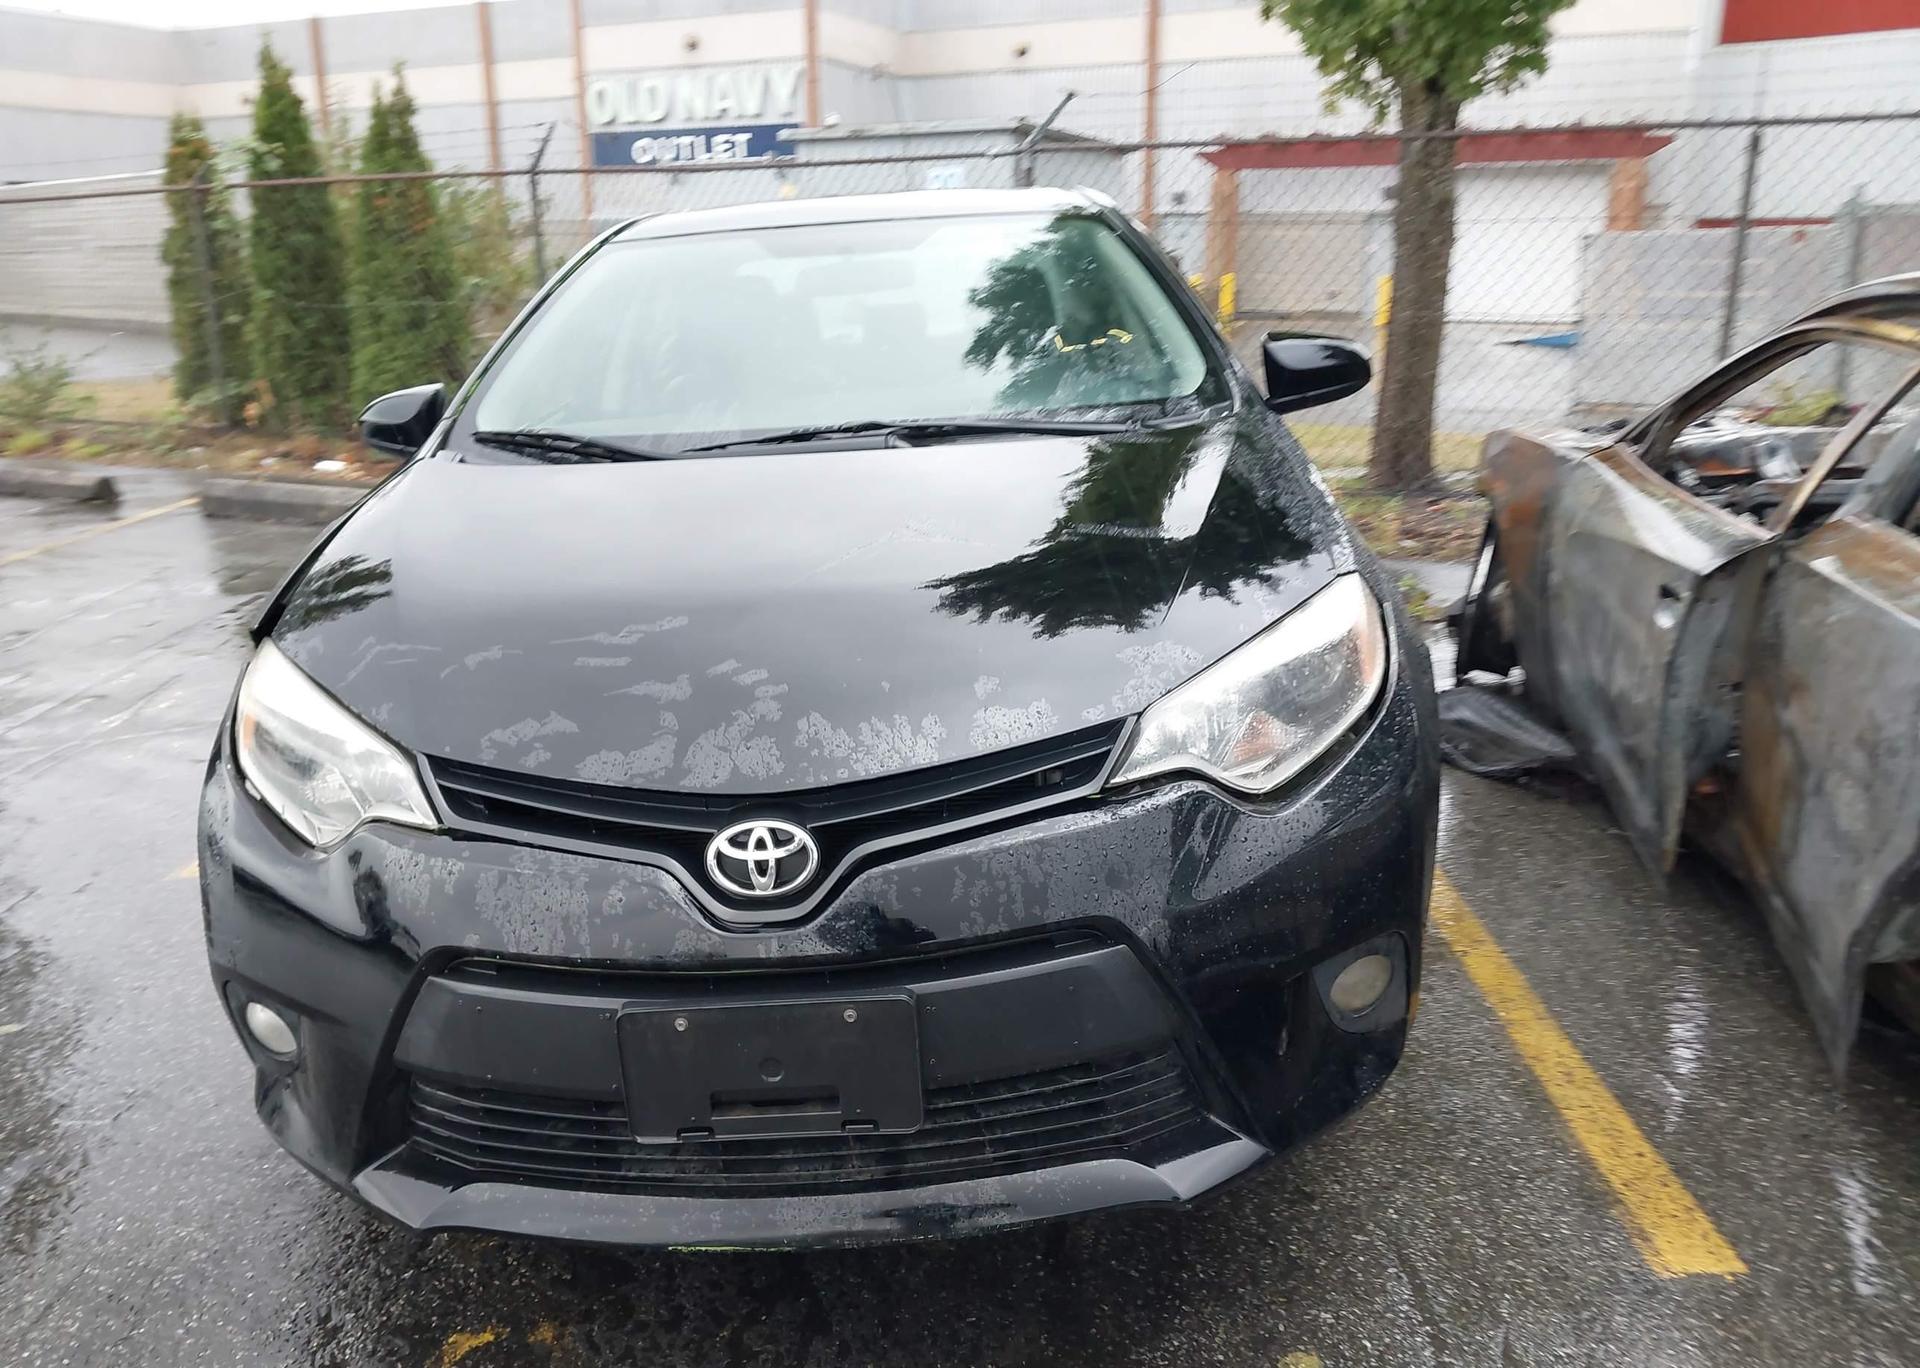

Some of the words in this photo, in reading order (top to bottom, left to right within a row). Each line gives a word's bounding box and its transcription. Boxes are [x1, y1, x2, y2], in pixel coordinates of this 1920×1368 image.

[586, 78, 668, 125] OLD
[676, 65, 805, 120] NAVY
[630, 132, 753, 164] OUTLET
